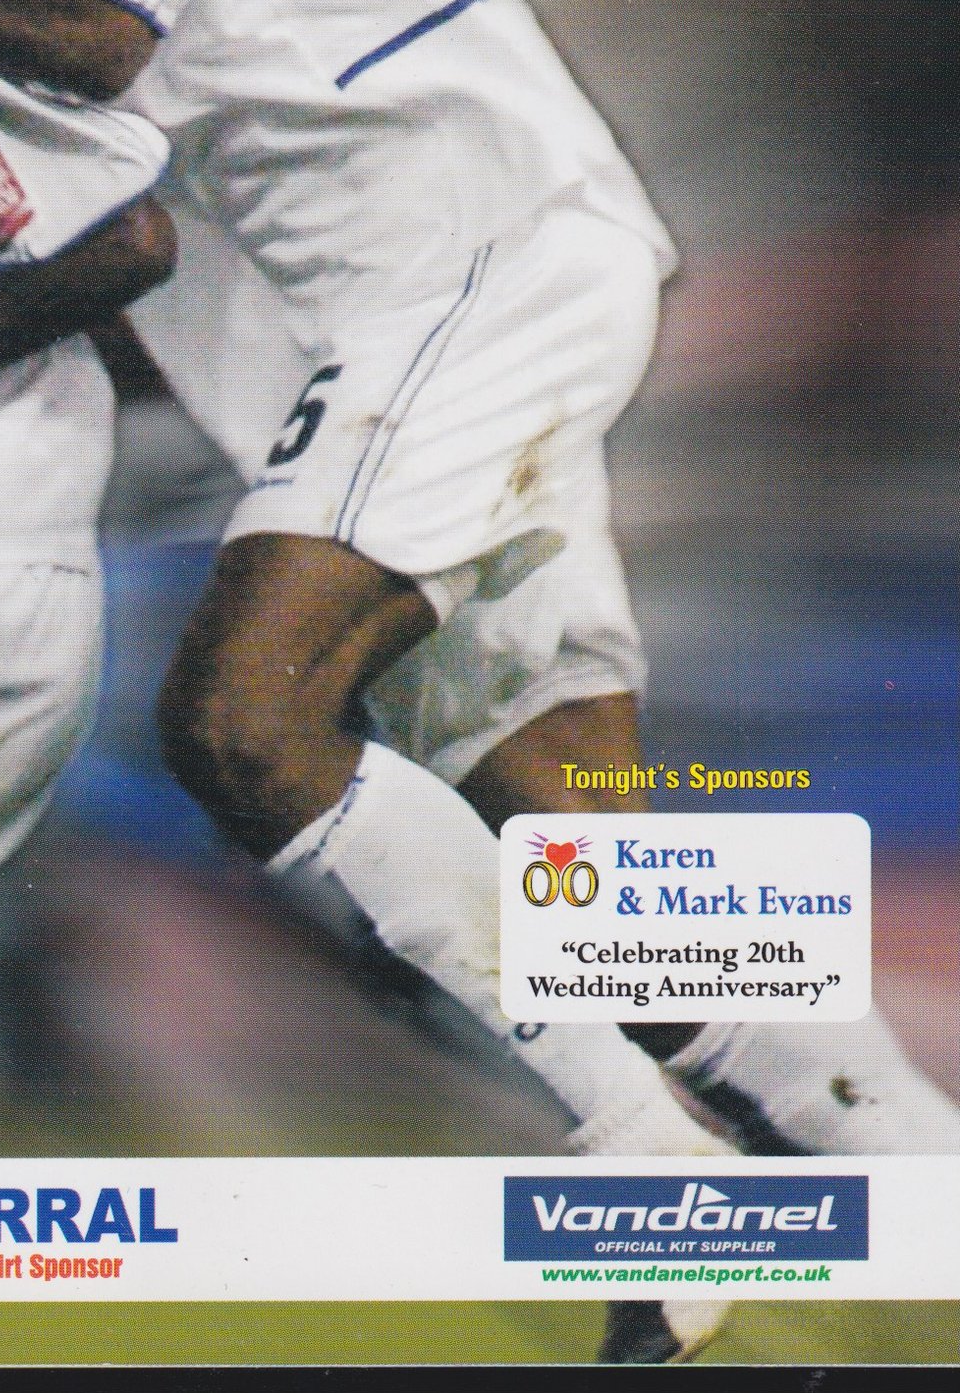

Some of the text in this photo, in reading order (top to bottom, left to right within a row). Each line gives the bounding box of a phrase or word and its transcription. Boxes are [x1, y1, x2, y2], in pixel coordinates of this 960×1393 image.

[561, 763, 811, 795] Tonight's Sponsors
[615, 839, 717, 870] Karen
[616, 885, 853, 917] & Mark Evans
[748, 941, 806, 965] 20th
[528, 975, 651, 1007] Wedding
[532, 1182, 839, 1232] Vandanel
[594, 1240, 777, 1254] OFFICIAL KIT SUPPLIER
[29, 1254, 124, 1283] Sponsor
[541, 1264, 832, 1286] www.vandanelsport.co.uk
